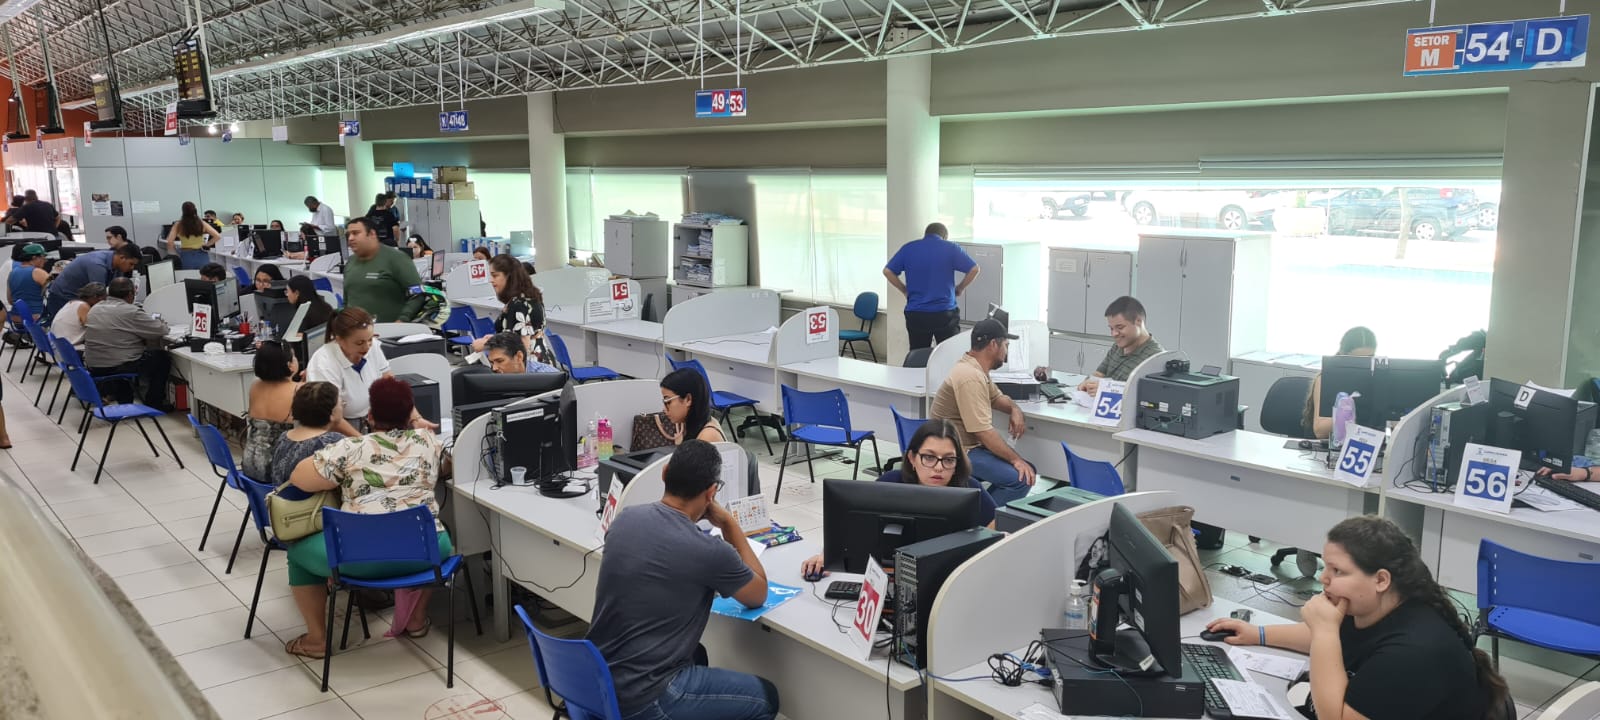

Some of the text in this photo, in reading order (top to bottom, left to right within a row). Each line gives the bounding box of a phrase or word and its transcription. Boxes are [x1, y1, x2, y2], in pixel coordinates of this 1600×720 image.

[1413, 35, 1450, 48] SETOR
[1466, 31, 1510, 63] 54
[1536, 28, 1563, 56] D
[1420, 48, 1440, 67] M
[712, 93, 725, 110] 49
[730, 94, 743, 112] 53
[471, 264, 484, 276] 49
[614, 284, 628, 297] 51
[195, 316, 207, 330] 26
[810, 313, 826, 330] 53
[1519, 391, 1530, 402] D
[1097, 397, 1122, 418] 54
[1341, 446, 1372, 474] 55
[1466, 468, 1506, 498] 56
[856, 590, 875, 634] 30
